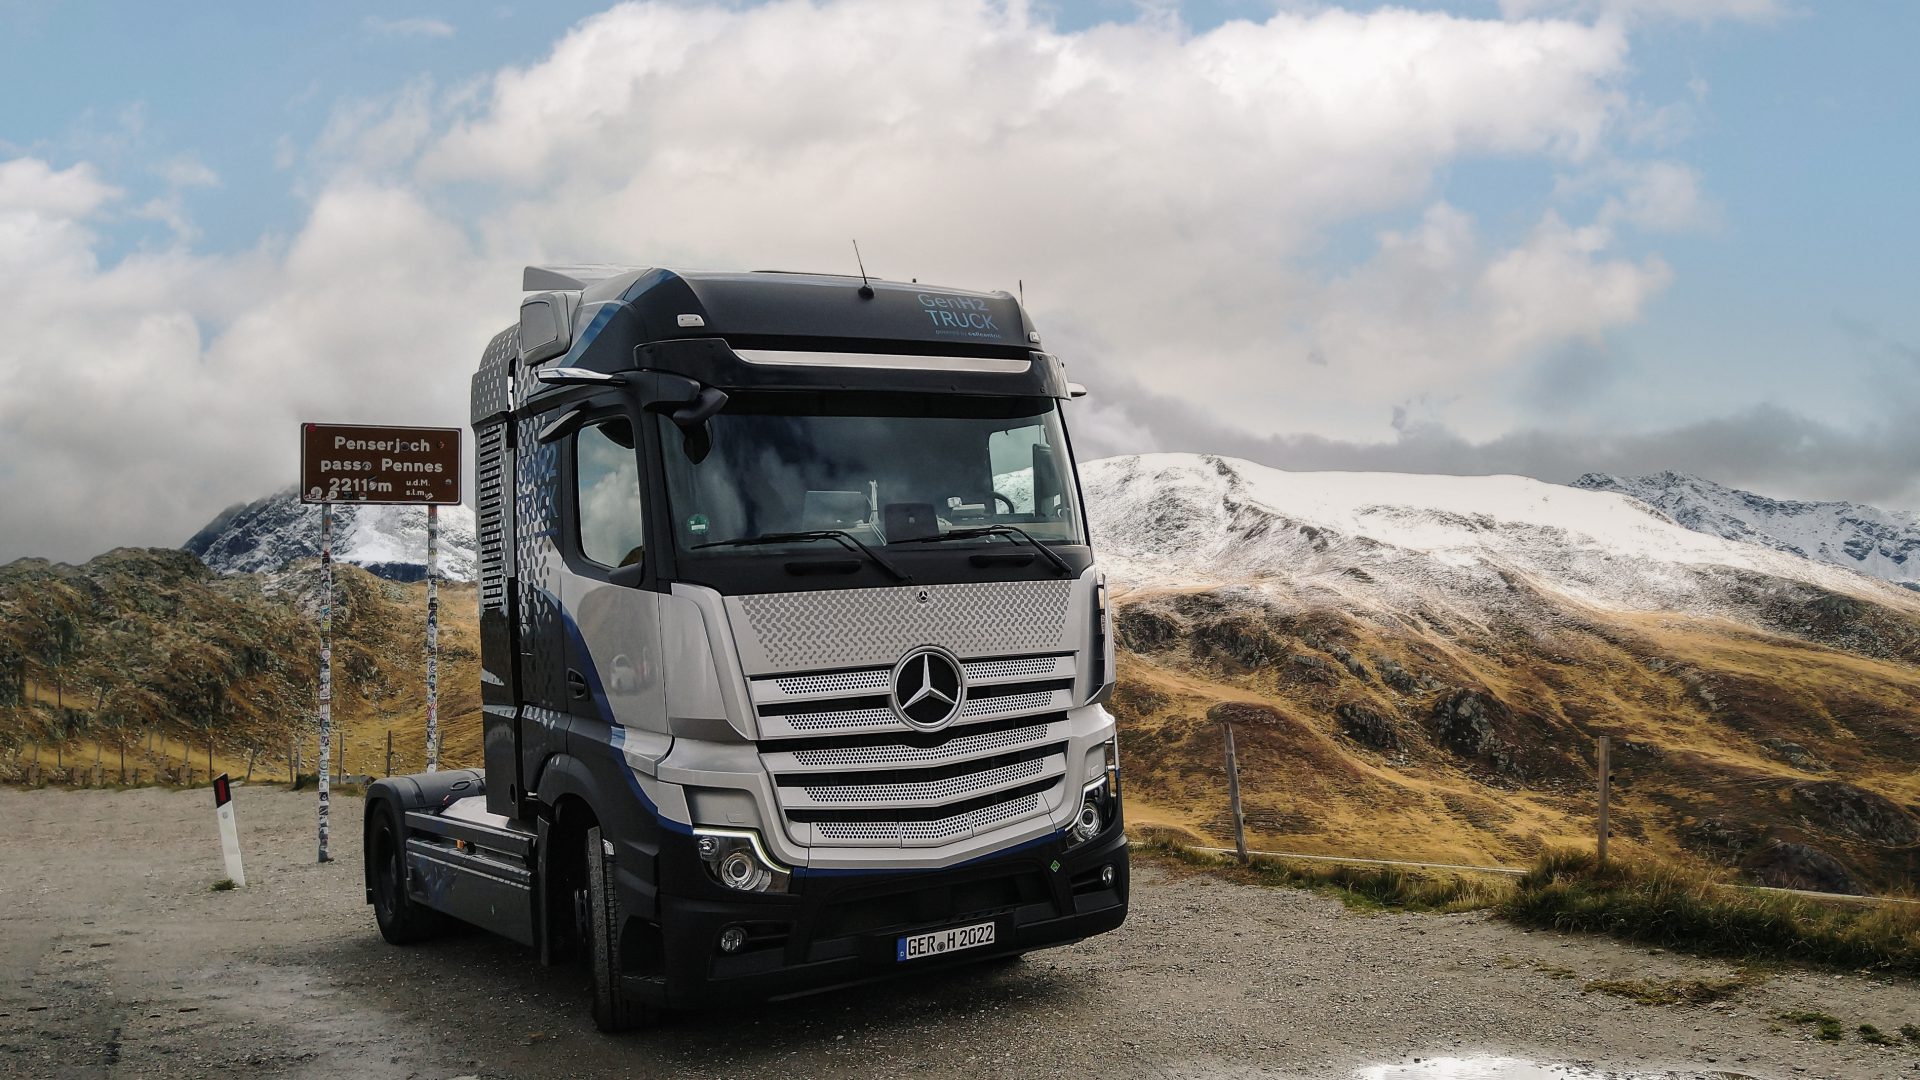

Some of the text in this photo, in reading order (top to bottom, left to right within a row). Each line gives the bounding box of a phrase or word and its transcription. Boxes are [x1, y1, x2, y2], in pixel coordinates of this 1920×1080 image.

[917, 293, 990, 311] GenH2
[924, 309, 999, 331] TRUCK
[334, 436, 430, 453] Penserjch
[381, 457, 443, 473] Pennes
[908, 935, 936, 956] GER
[947, 931, 956, 949] H
[959, 925, 993, 946] 2022
